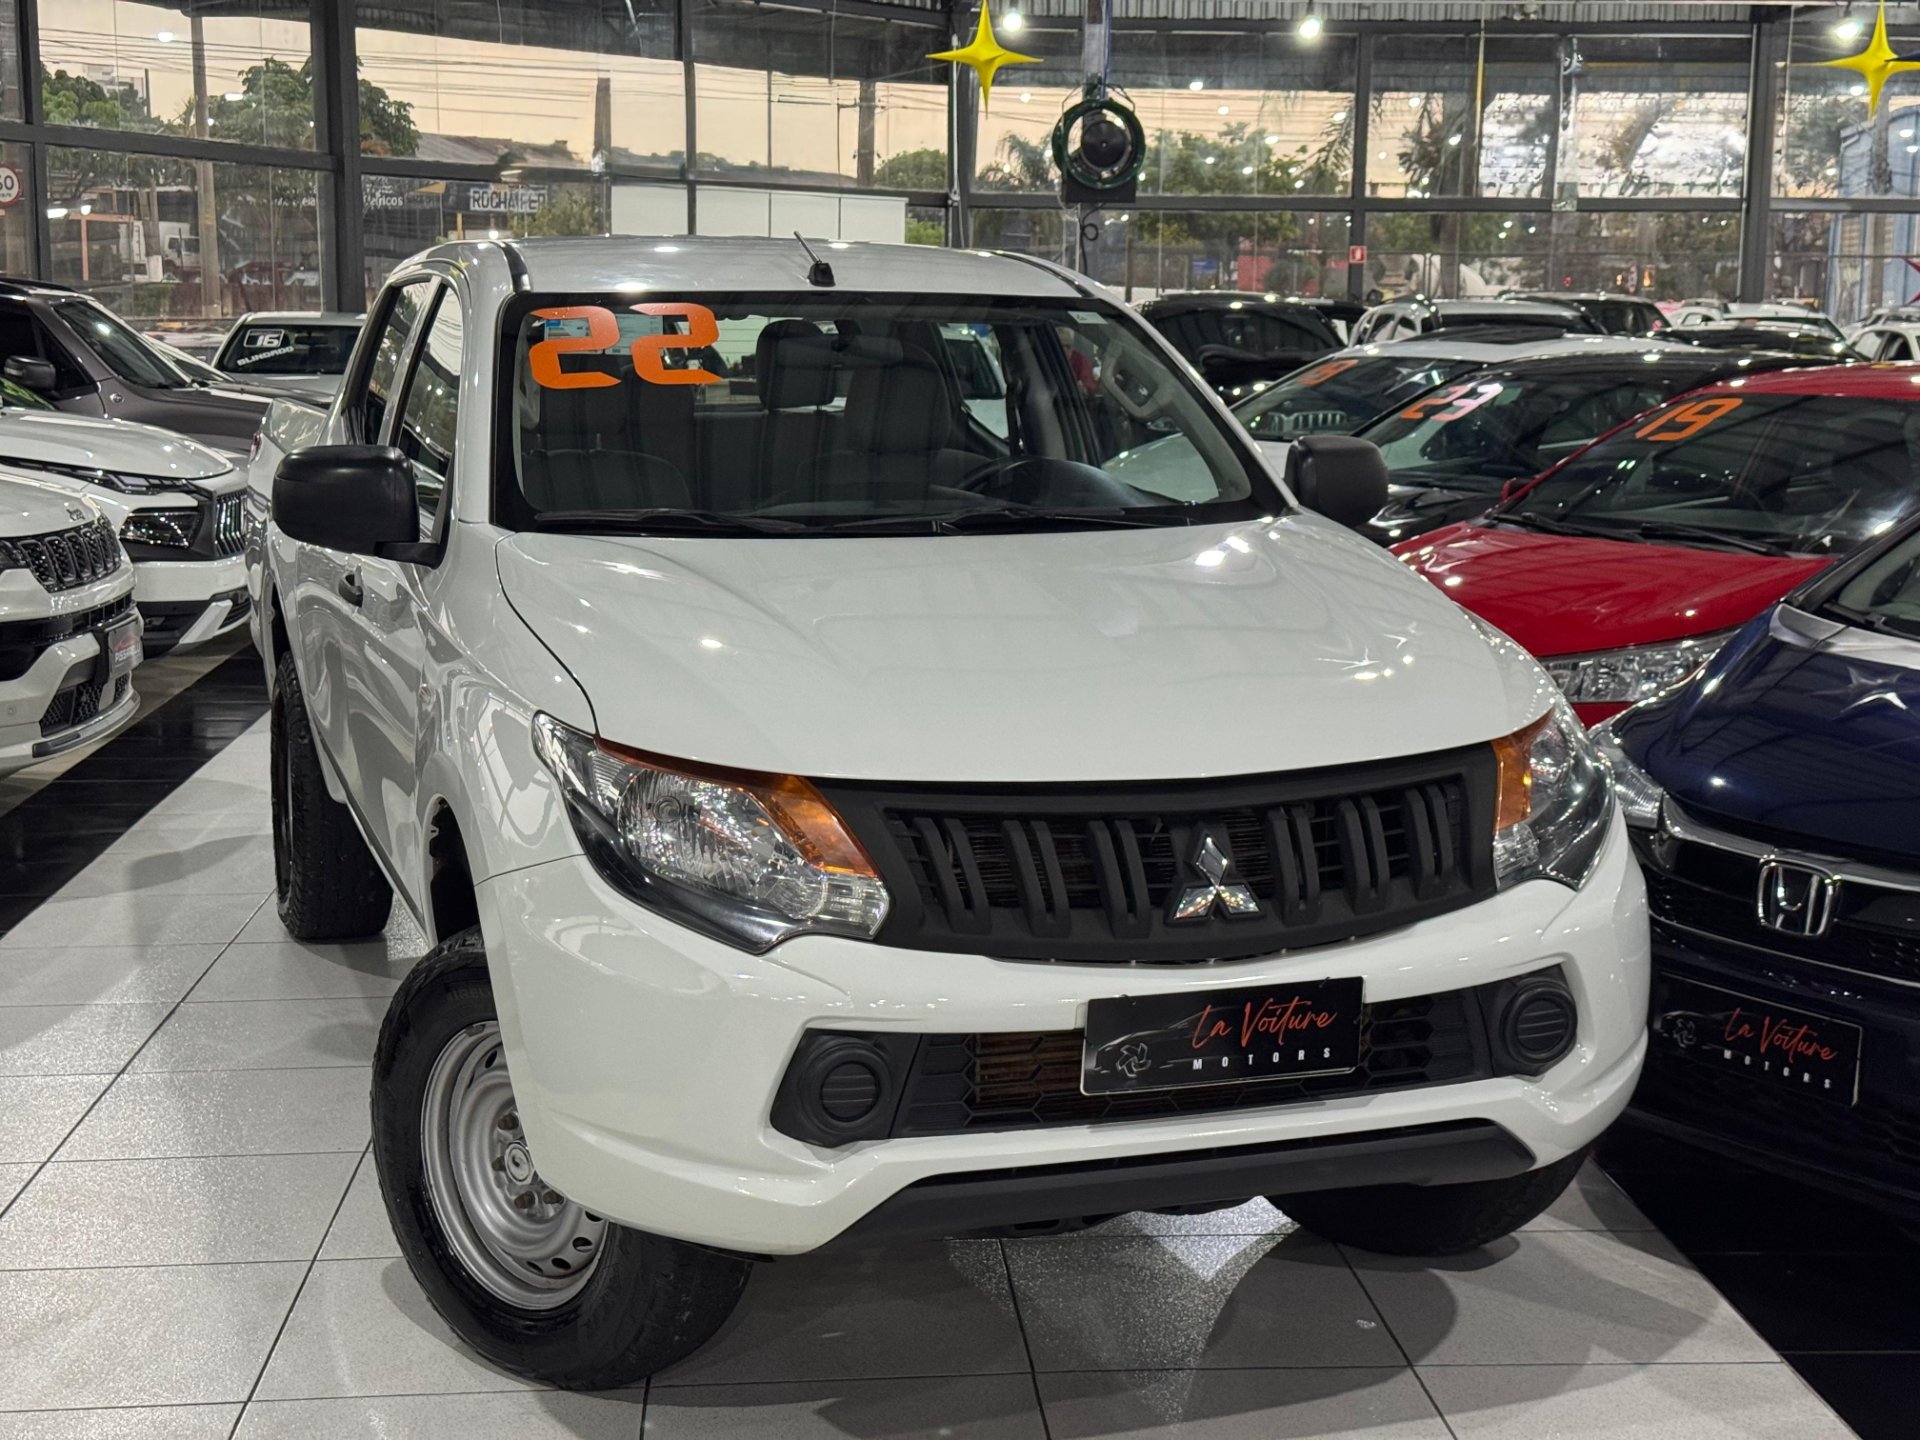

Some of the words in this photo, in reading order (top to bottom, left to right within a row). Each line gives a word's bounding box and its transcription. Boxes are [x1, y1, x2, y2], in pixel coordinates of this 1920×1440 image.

[236, 345, 294, 366] BLINDADO
[256, 334, 281, 348] 16
[529, 303, 724, 389] 22
[1400, 383, 1504, 421] 23
[1635, 398, 1744, 442] 19
[1192, 1004, 1232, 1049] La
[1241, 995, 1338, 1048] Voiture
[1724, 1007, 1754, 1041] La
[1759, 1016, 1838, 1063] Voiture
[1193, 1047, 1331, 1071] MOTORS
[1724, 1049, 1832, 1089] MOTORS
